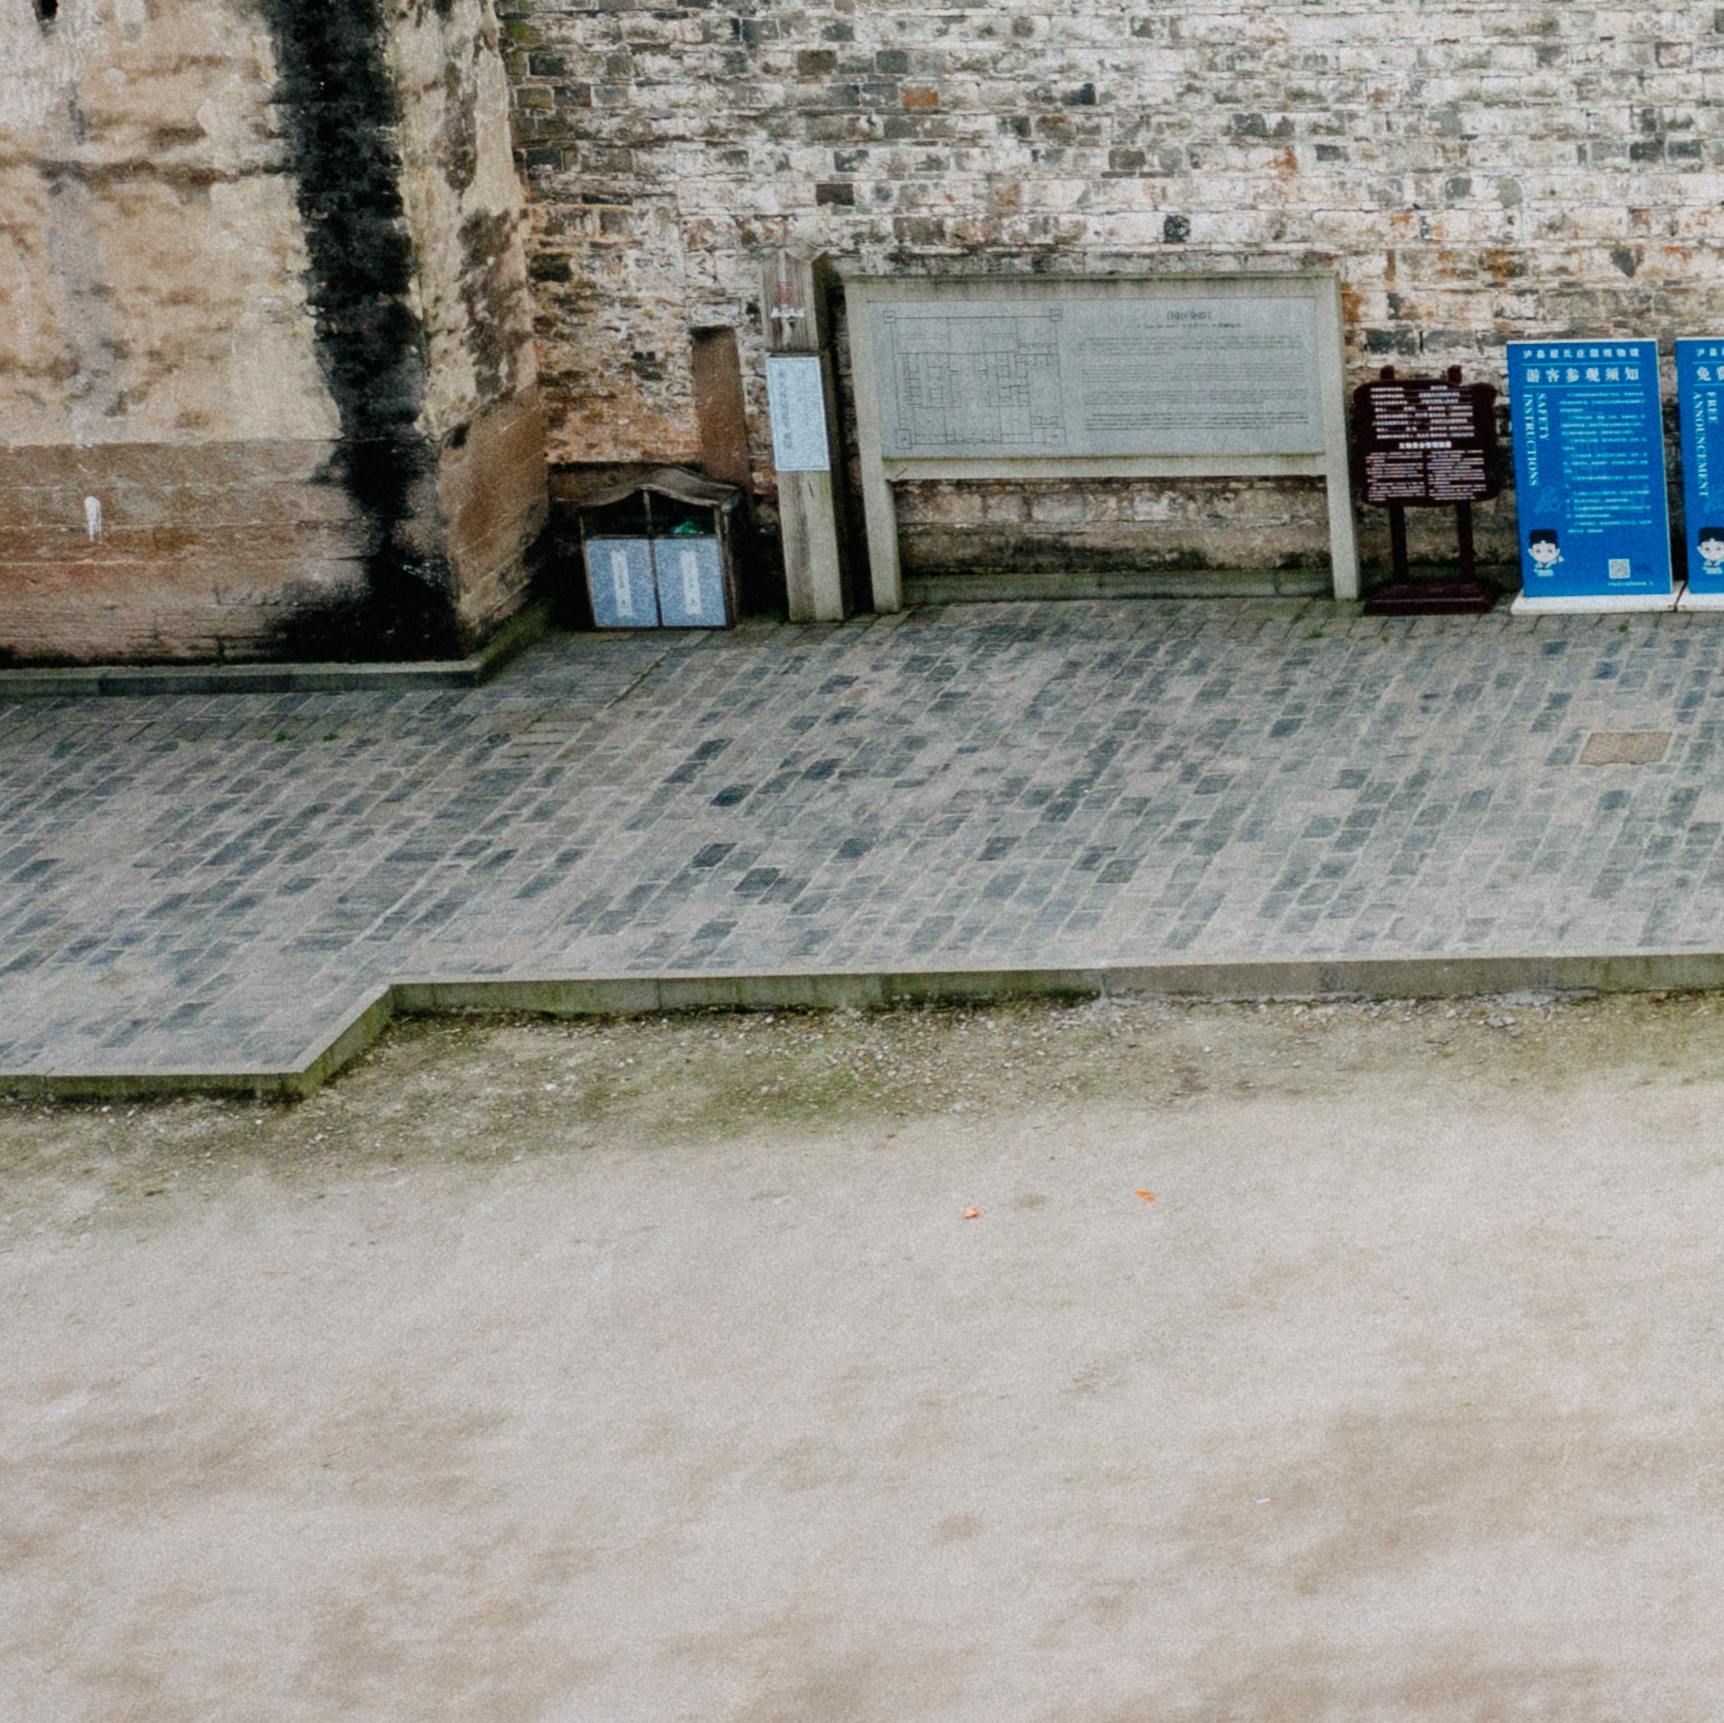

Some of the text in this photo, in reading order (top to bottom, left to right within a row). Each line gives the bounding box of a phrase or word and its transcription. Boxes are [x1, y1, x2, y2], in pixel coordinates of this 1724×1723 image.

[1526, 367, 1640, 383] 游客参观须知
[1537, 393, 1549, 441] SAFETY
[1706, 391, 1718, 424] FREE
[1523, 393, 1539, 486] INSTRUCTIONS
[1693, 391, 1709, 498] ANNOUNCEMENT
